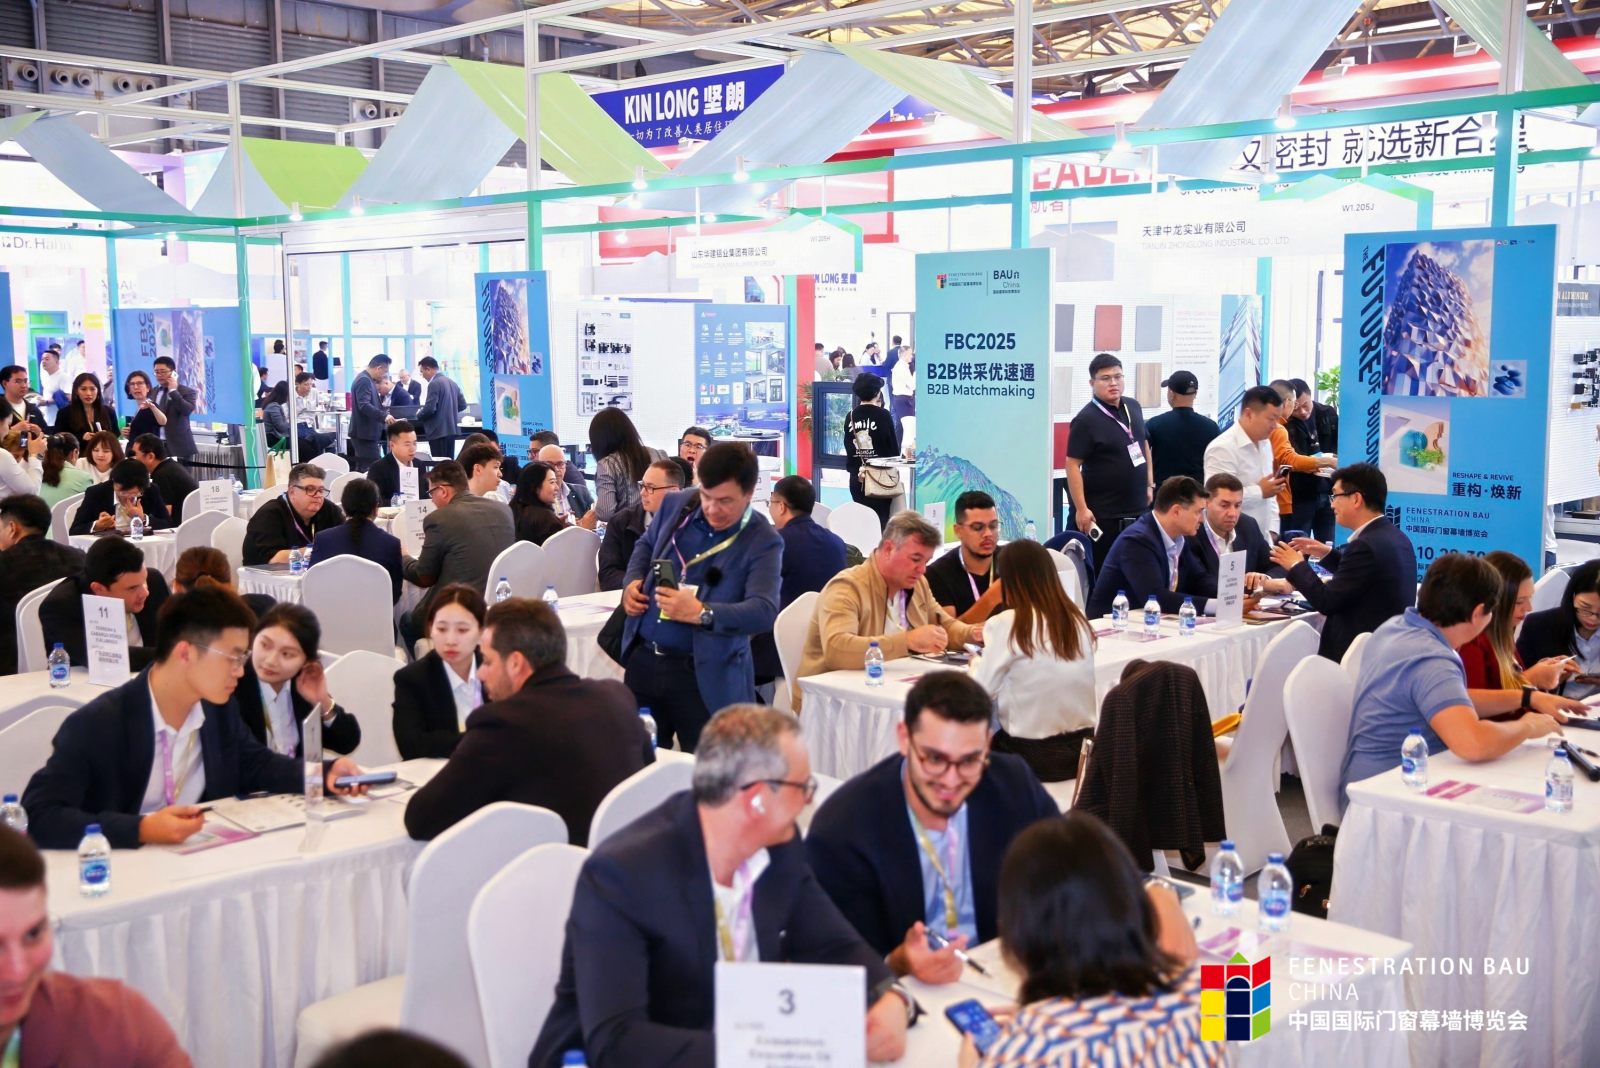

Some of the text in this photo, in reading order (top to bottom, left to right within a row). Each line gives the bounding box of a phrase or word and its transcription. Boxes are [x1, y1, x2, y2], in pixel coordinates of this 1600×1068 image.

[624, 80, 746, 125] KIN LONG 坚朗
[1342, 113, 1526, 164] 就选新合
[1341, 202, 1375, 213] W1.205J
[1141, 219, 1247, 238] 天津中龙实业有限公司
[13, 236, 32, 249] Dr.
[821, 272, 839, 285] LONG
[1359, 244, 1385, 383] FUTURE
[138, 312, 150, 357] FBC
[944, 331, 1017, 351] FBC2025
[927, 362, 1035, 382] B2B供采优速通
[927, 383, 1035, 400] B2B Matchmaking
[1452, 472, 1482, 480] RESHAPE
[210, 485, 220, 493] 18
[417, 505, 427, 514] 14
[1406, 506, 1490, 520] FENESTRATION BAU
[1405, 516, 1430, 524] CHINA
[1405, 524, 1489, 539] 中国国际门窗幕墙博览会
[1230, 560, 1236, 571] 5
[99, 606, 109, 619] 11
[778, 988, 796, 1016] 3
